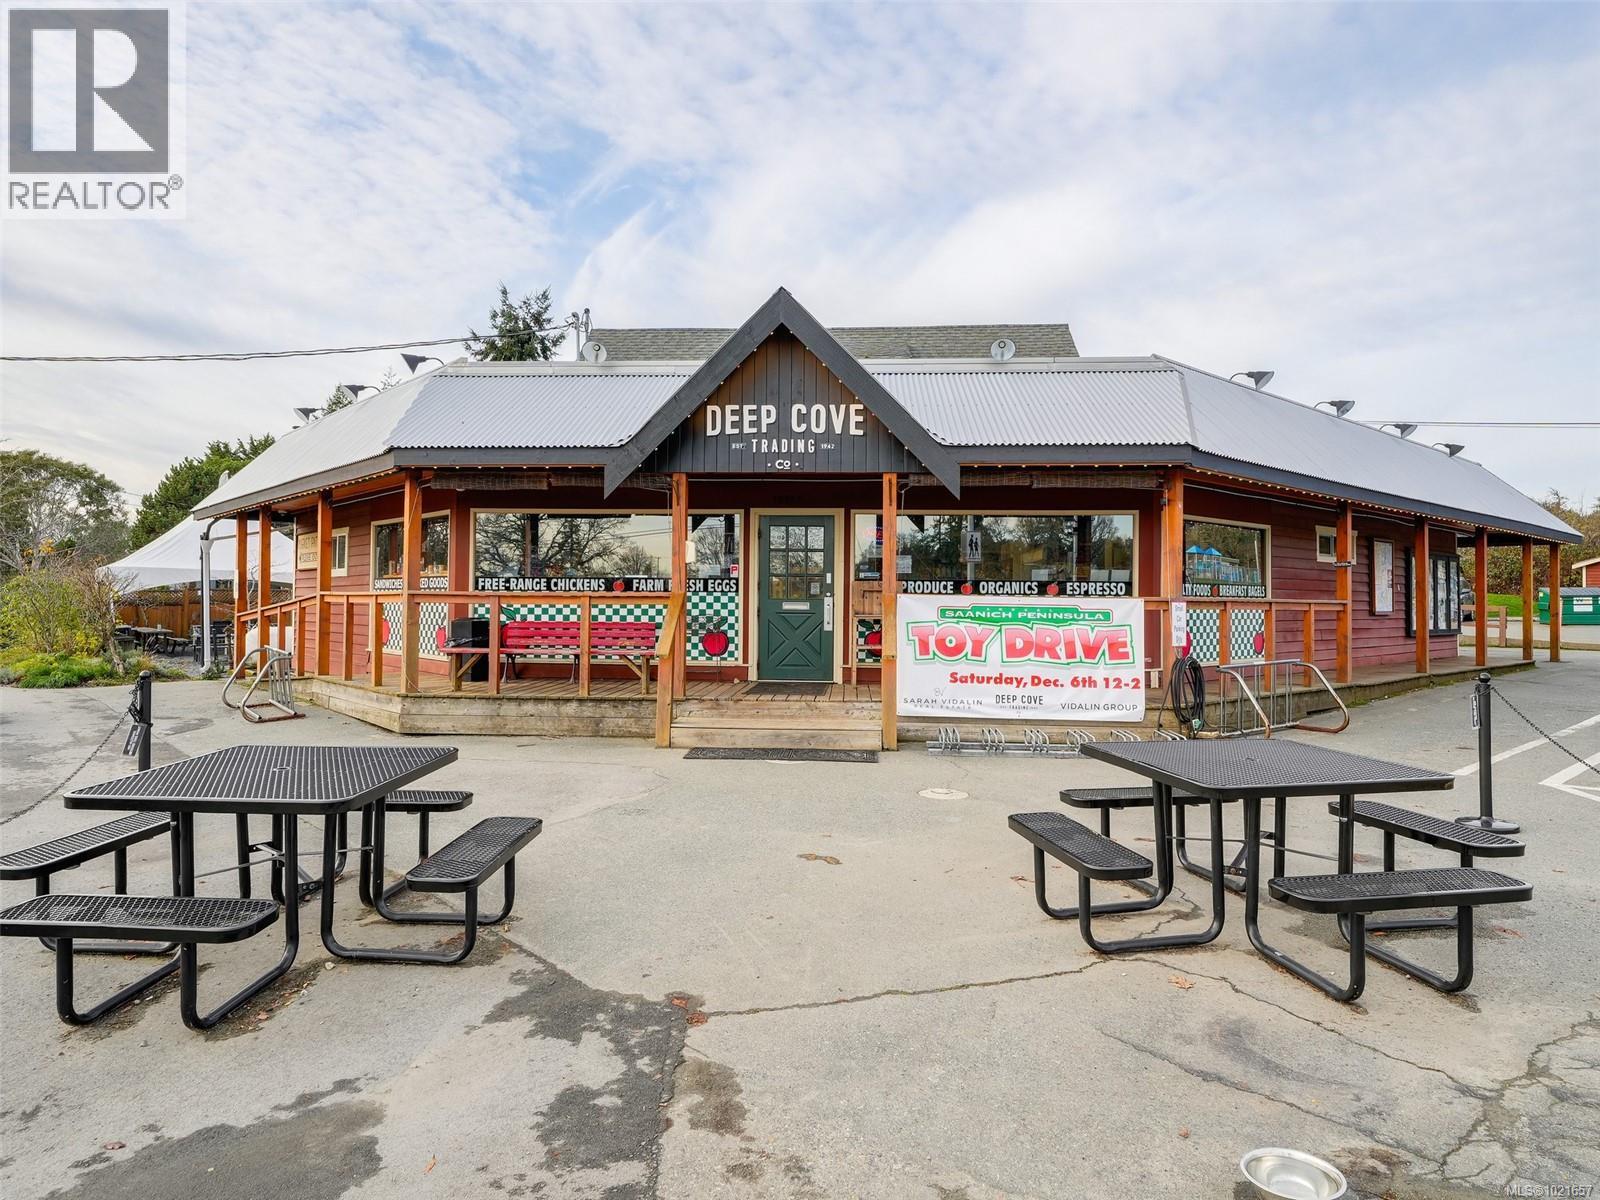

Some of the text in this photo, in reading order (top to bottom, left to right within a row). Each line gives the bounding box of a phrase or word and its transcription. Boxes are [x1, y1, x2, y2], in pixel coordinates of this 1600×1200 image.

[706, 403, 864, 437] DEEP COVE
[751, 439, 815, 453] TRADING
[429, 577, 448, 588] GOODS
[478, 577, 737, 592] FREE-RANGE CHICKENS FARM FSH EGGS
[902, 581, 1126, 596] PRODUCE ORGANICS ESPRESSO
[1193, 583, 1211, 597] FOODS
[1219, 584, 1247, 597] BREAKFAST
[1248, 585, 1265, 597] BAGELS
[909, 623, 1132, 663] TOY DRIVE
[949, 672, 1141, 690] Saturday, Dec. 6th 12-2
[995, 694, 1044, 706] DEEP COVE
[1060, 703, 1138, 712] VIDALIN GROUP
